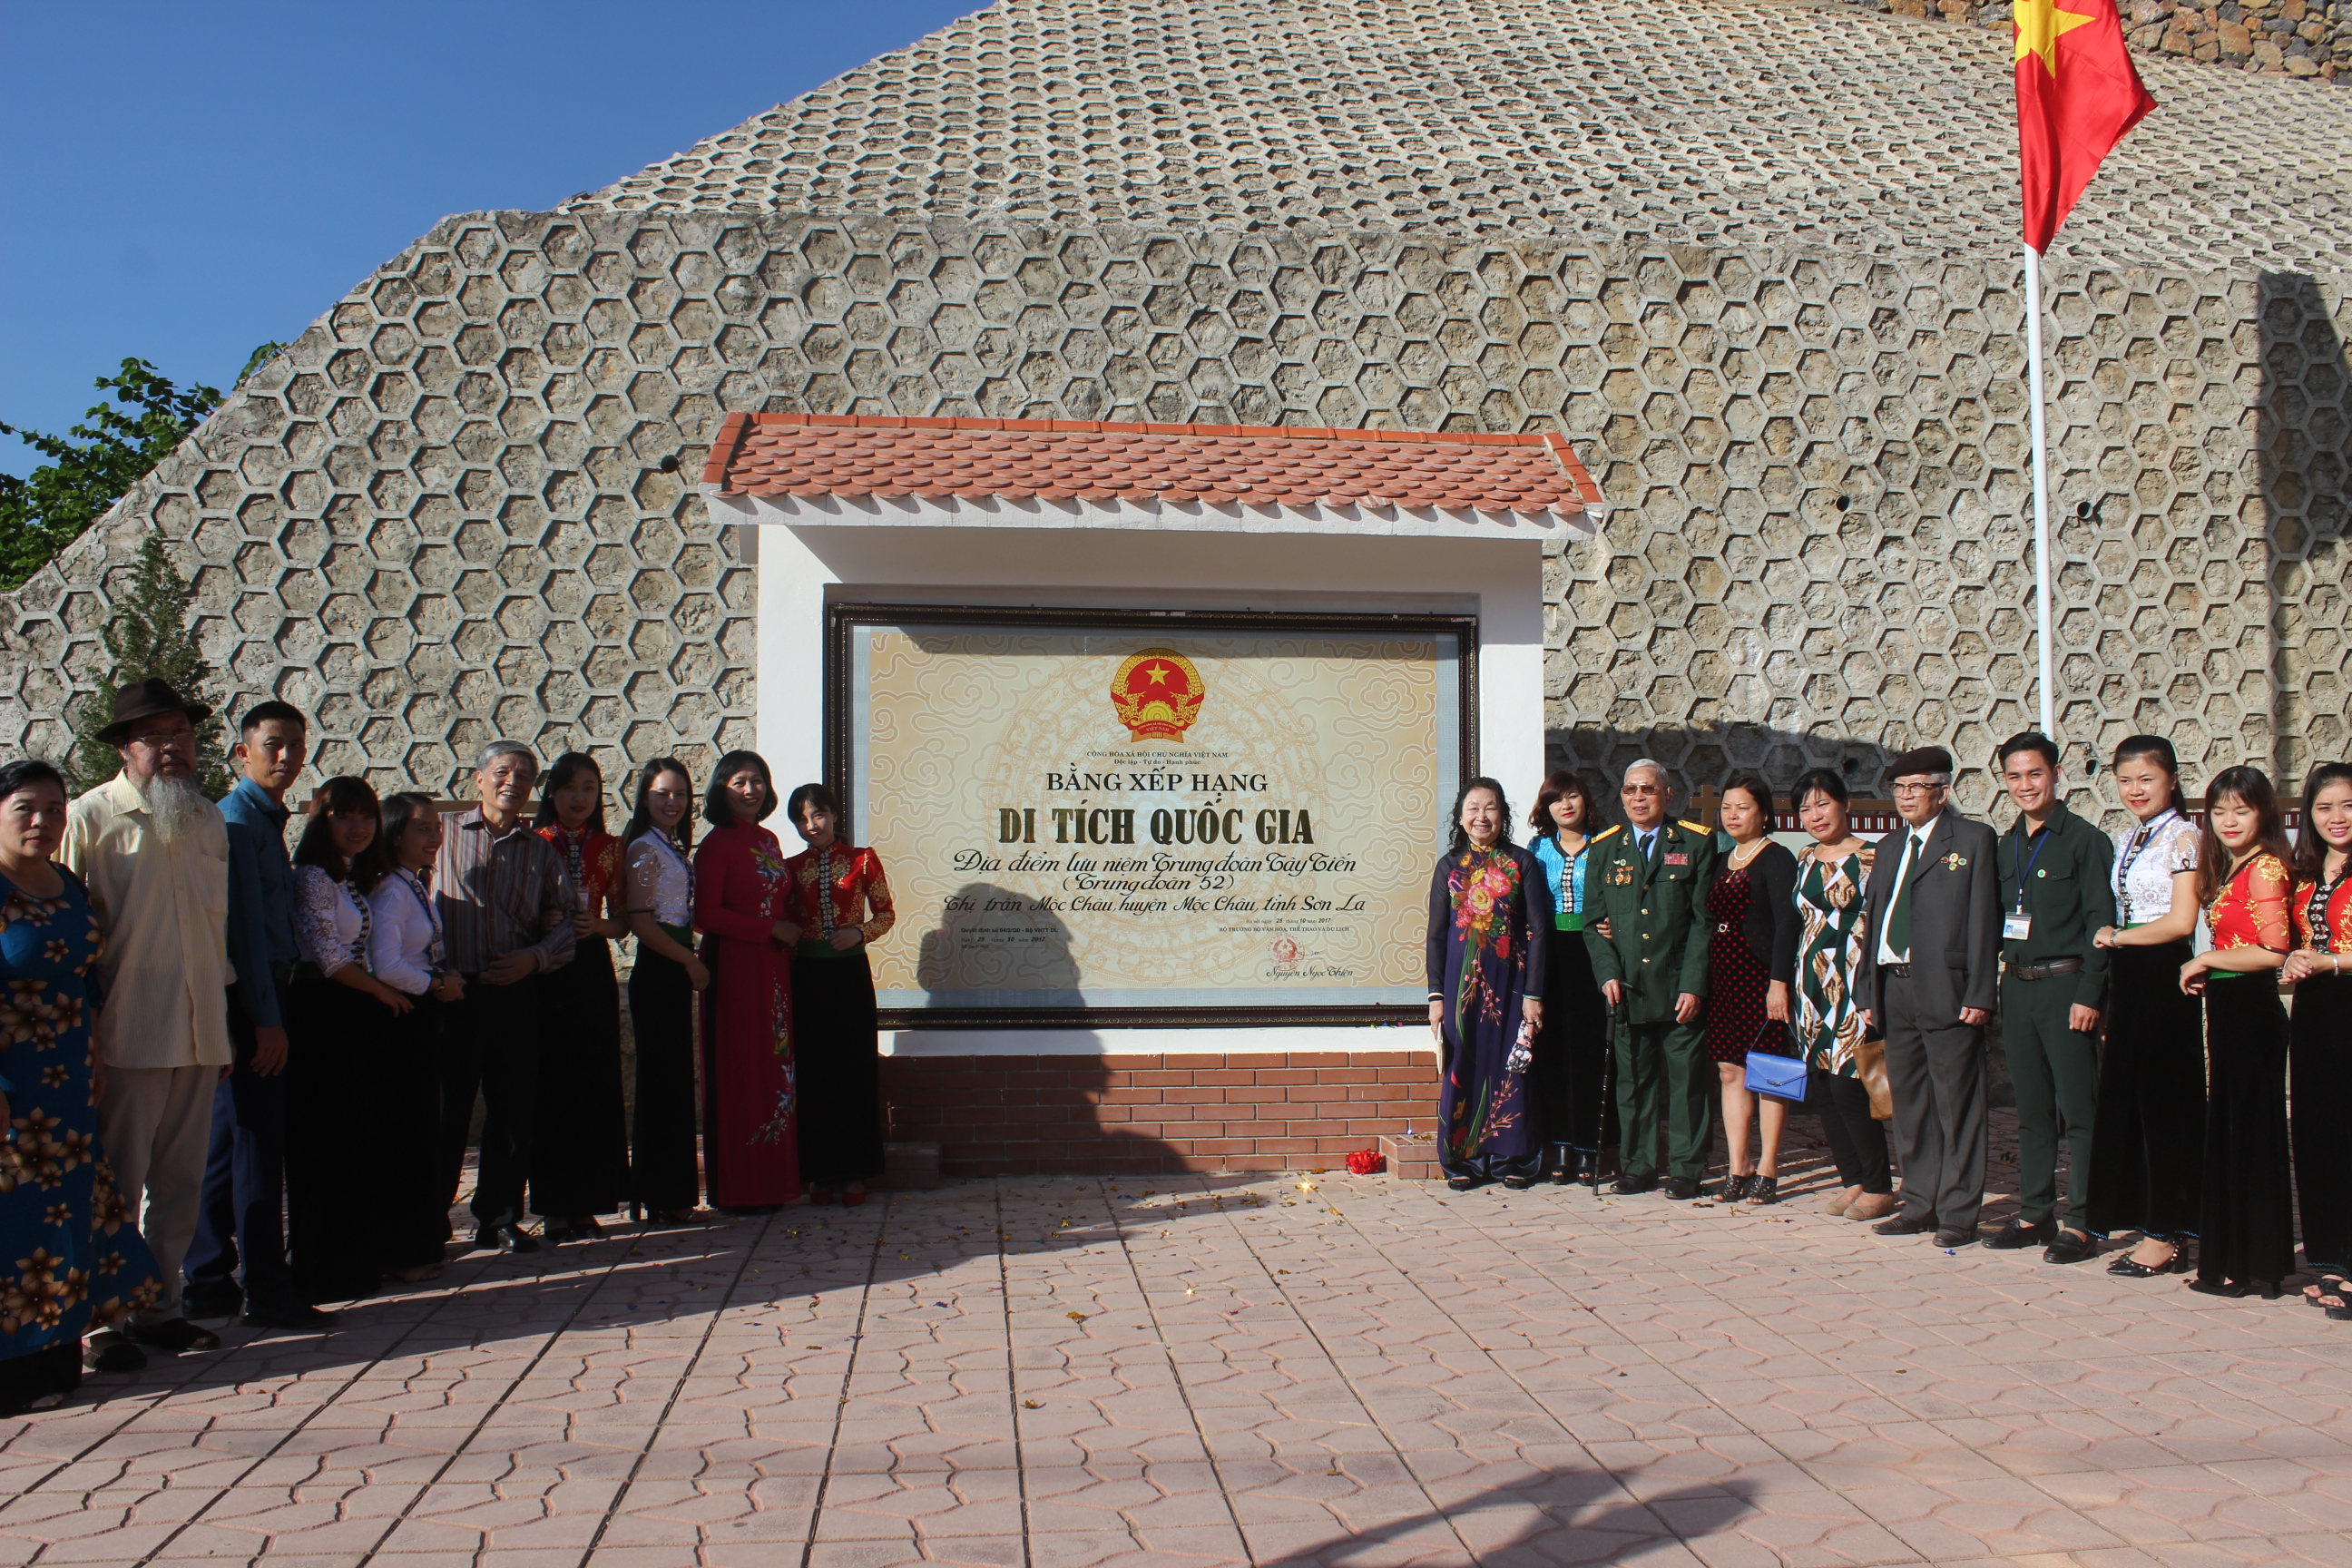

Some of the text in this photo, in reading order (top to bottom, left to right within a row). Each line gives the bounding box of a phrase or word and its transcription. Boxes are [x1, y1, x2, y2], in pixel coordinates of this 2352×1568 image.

[1087, 750, 1107, 759] CỘNG
[1137, 750, 1150, 759] HỘI
[1194, 750, 1210, 759] VIỆT
[1046, 762, 1268, 797] BẰNG XẾP HẠNG
[998, 799, 1314, 845] DI TÍCH QUỐC GIA
[954, 848, 1356, 877] Địa điểm lưu niệm Trung đoàn Tây Tiến
[1141, 870, 1191, 890] đoàn
[1200, 874, 1234, 890] 52)
[944, 894, 1366, 916] Thị trấn Mộc Châu, huyện Mộc Châu, tỉnh Sơn La
[1303, 965, 1327, 982] Ngọc
